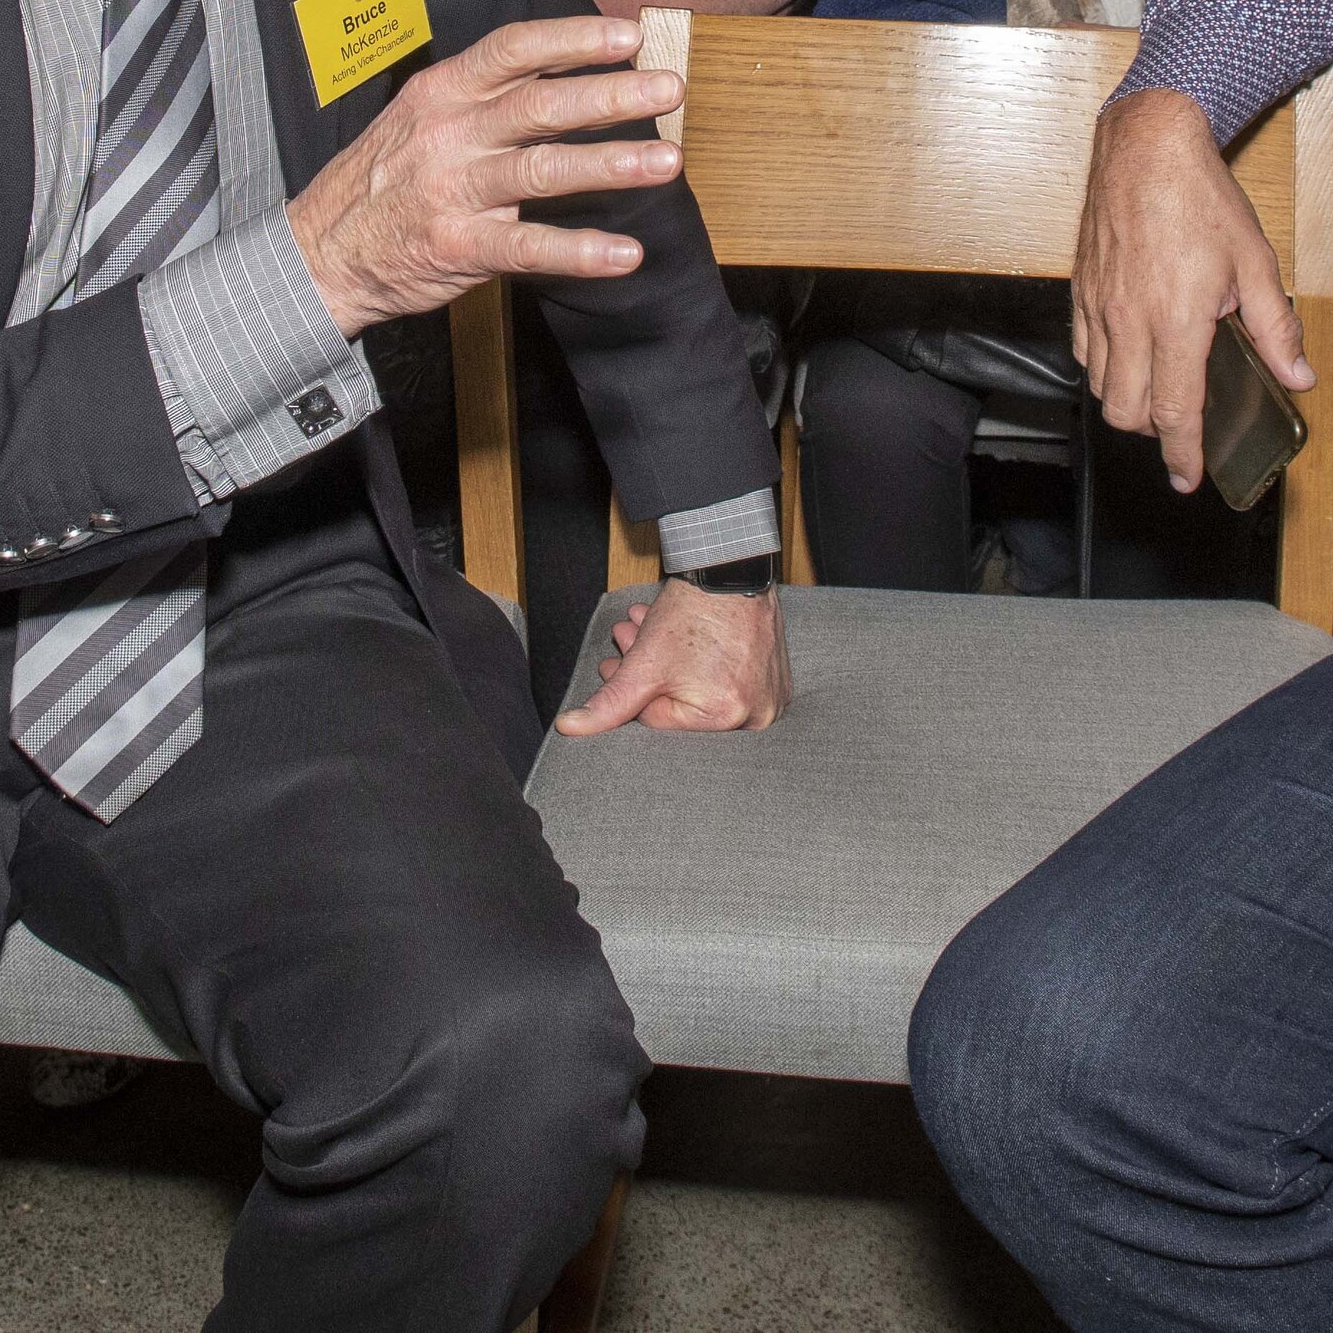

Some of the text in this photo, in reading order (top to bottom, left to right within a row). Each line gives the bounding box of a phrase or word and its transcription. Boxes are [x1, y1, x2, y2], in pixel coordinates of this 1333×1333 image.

[340, 18, 399, 62] McKenzie
[342, 1, 387, 35] Bruce
[332, 27, 416, 86] Acting Vice-Chancellor
